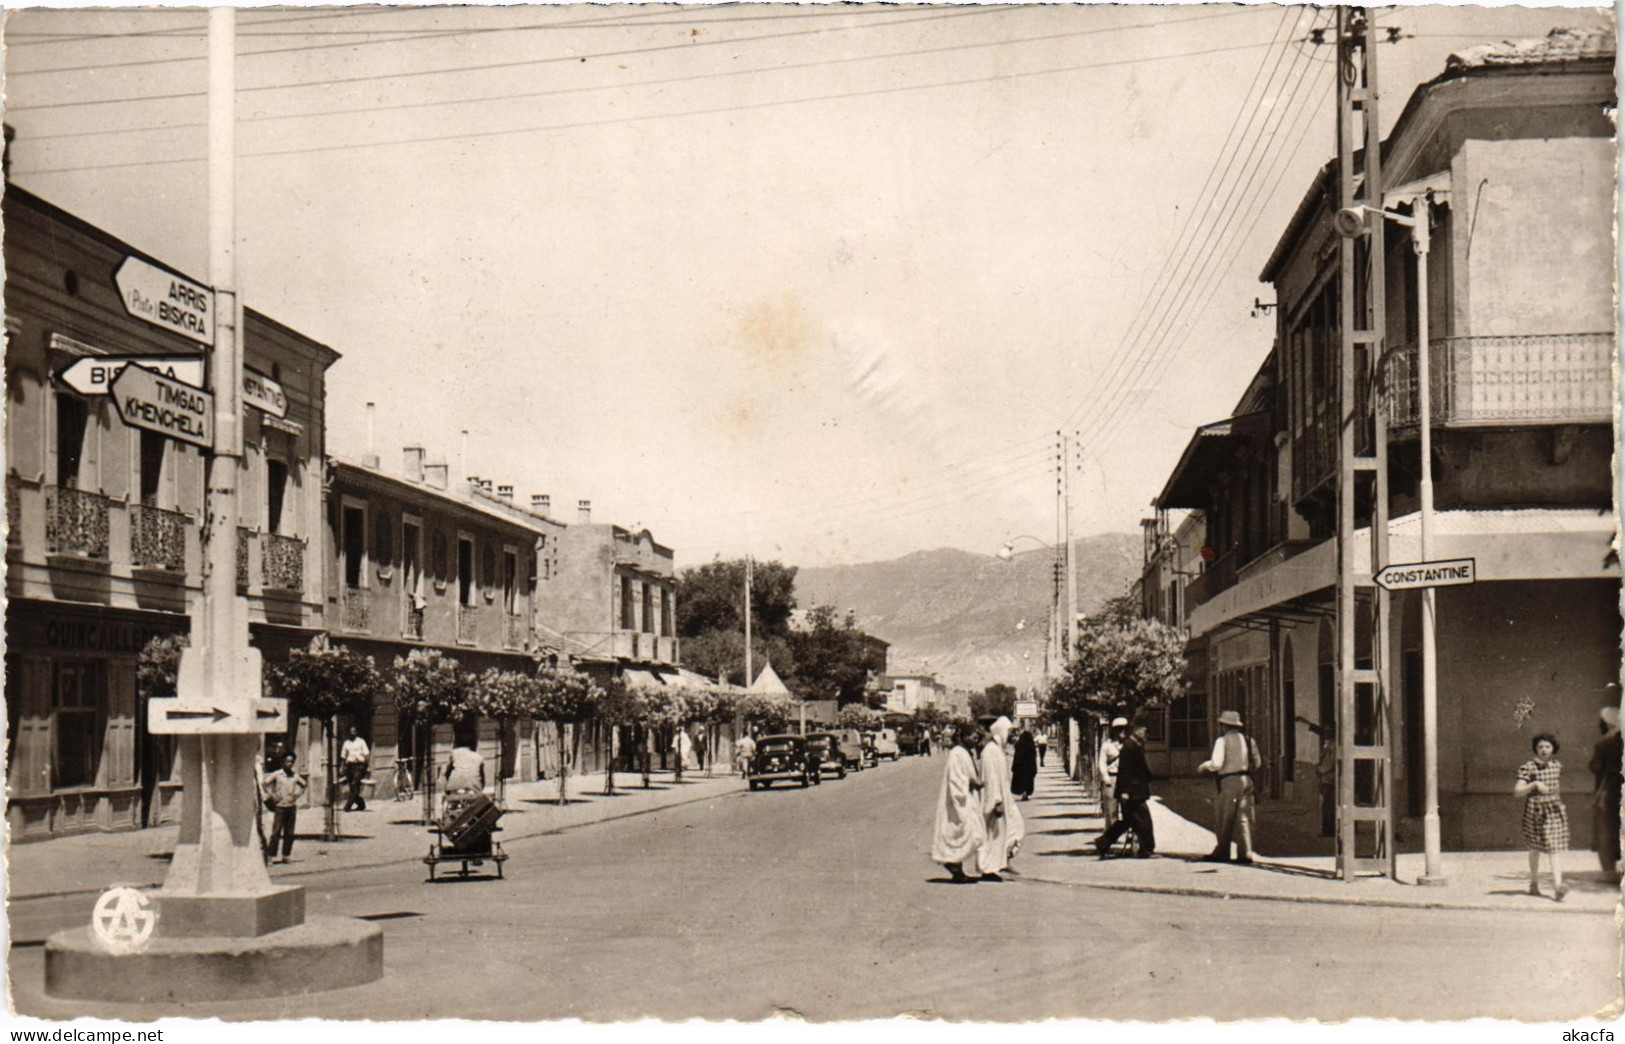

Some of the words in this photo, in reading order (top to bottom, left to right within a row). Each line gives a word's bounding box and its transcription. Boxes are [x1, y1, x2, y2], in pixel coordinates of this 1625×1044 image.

[168, 280, 207, 313] ARRIS
[159, 300, 206, 335] BISKRA
[155, 379, 205, 415] TIMGAD
[125, 396, 204, 437] KHENCHELA
[1385, 566, 1469, 584] CONSTANTINE
